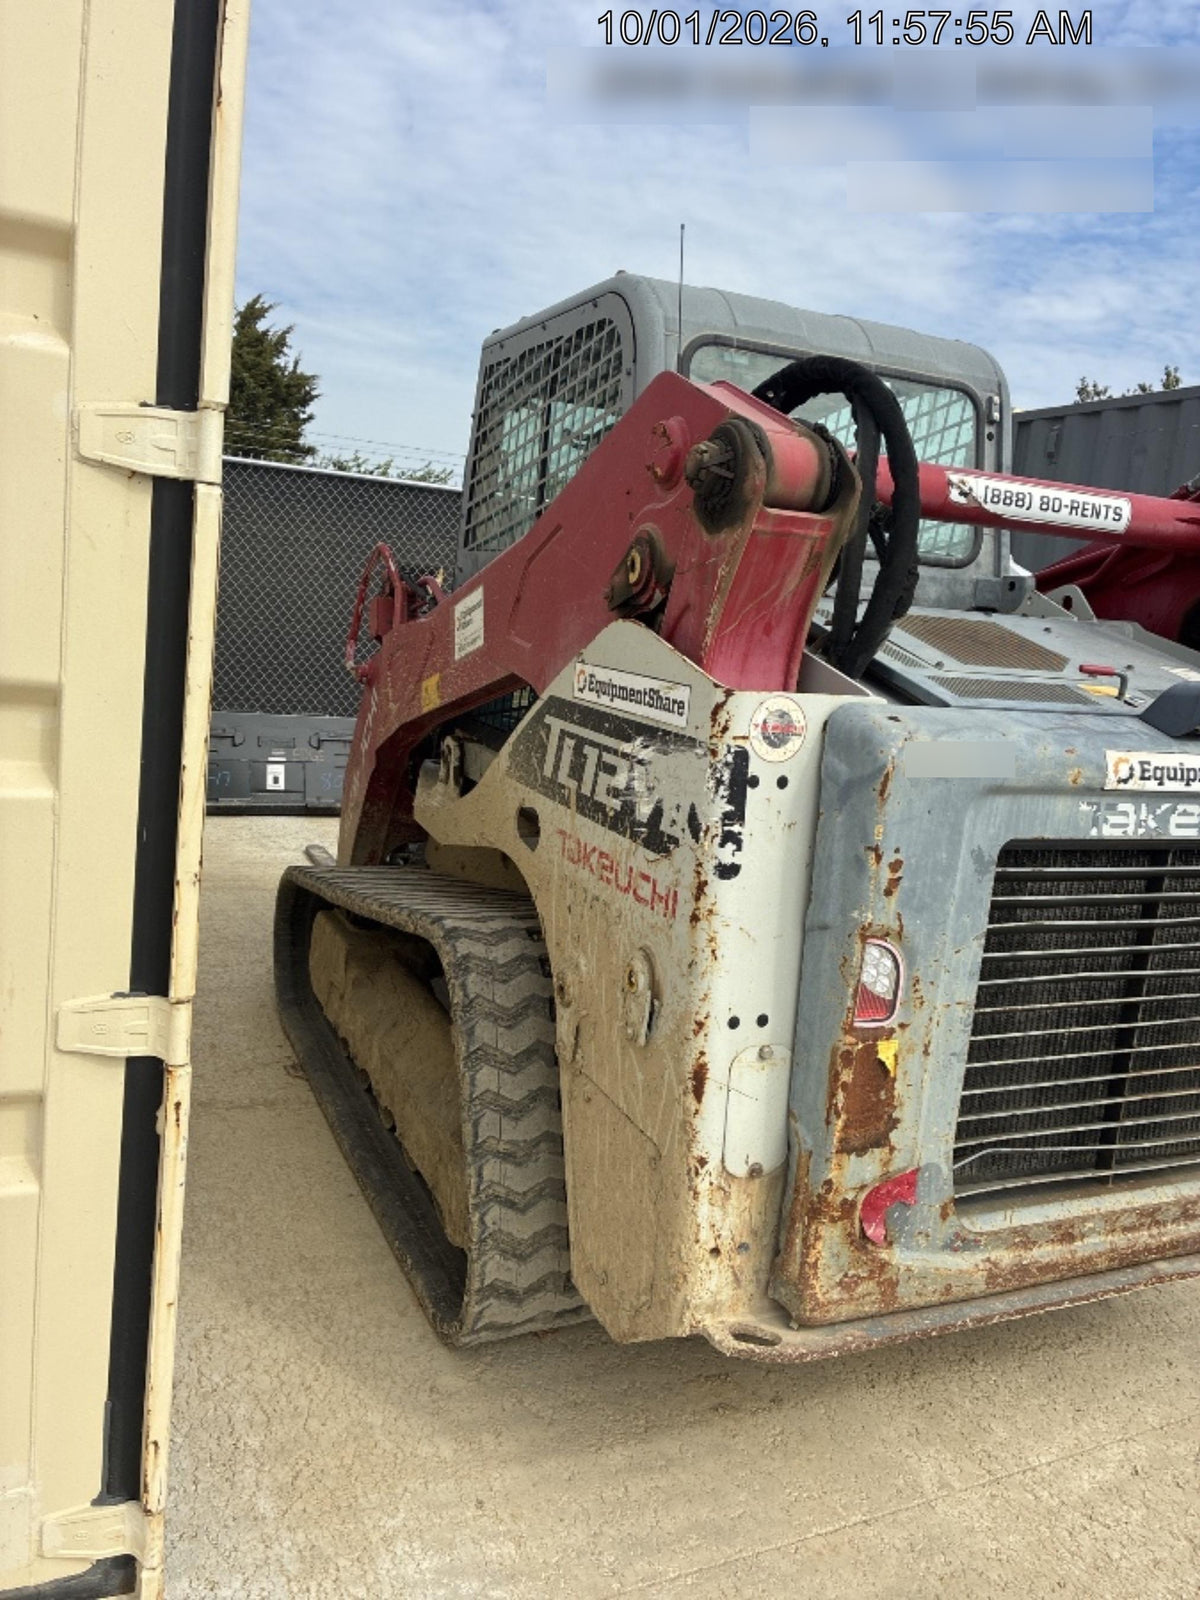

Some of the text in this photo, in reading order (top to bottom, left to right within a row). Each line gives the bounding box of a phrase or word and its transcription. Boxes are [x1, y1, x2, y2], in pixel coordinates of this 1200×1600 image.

[983, 484, 1123, 522] (888) 80-RENTS
[587, 672, 686, 717] EquipmentShare
[1138, 760, 1200, 788] Equip
